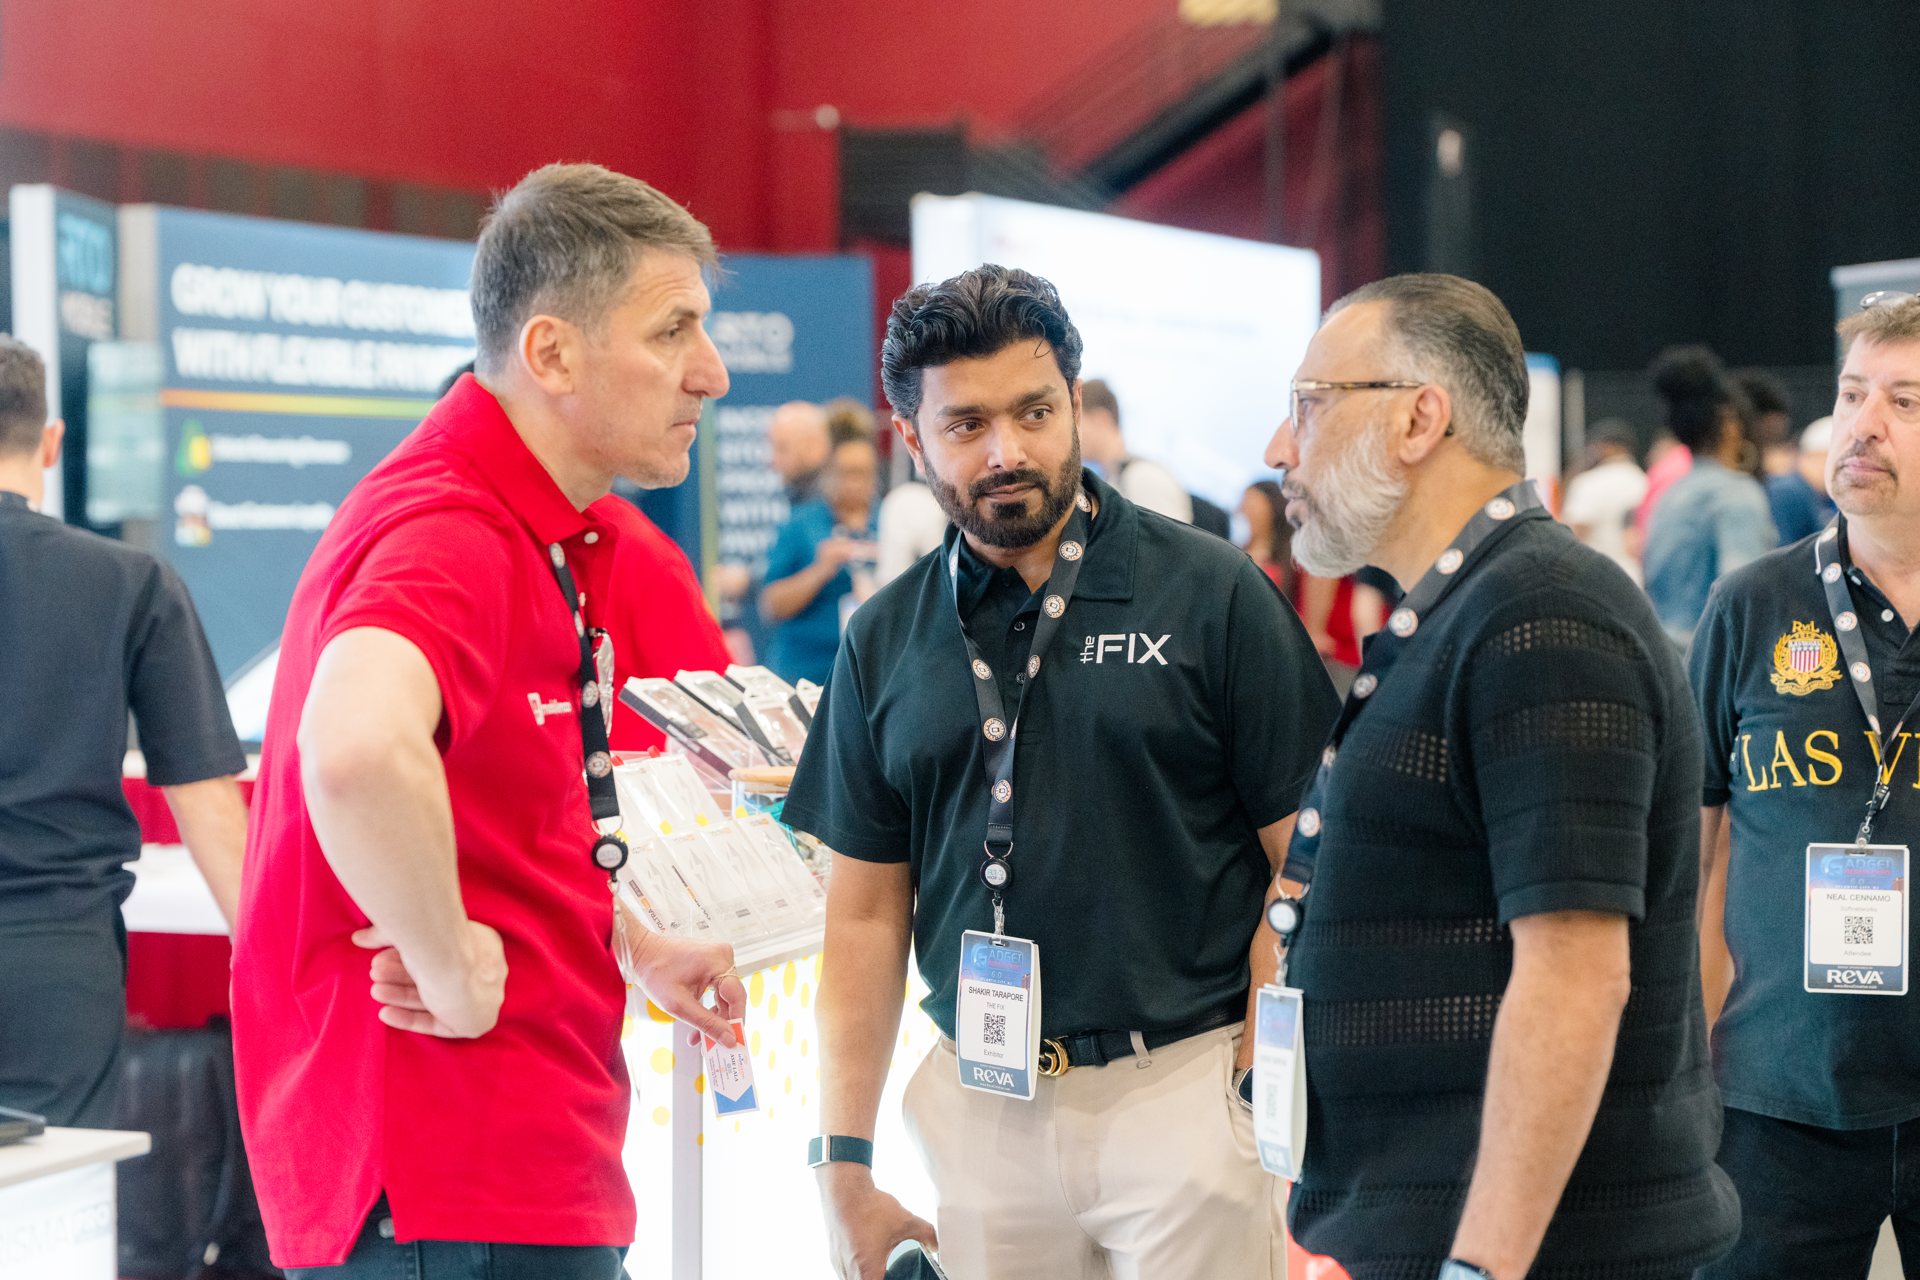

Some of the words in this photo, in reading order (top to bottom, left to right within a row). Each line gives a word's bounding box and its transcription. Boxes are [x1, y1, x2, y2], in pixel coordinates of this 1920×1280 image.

[1080, 635, 1095, 664] the
[1096, 632, 1172, 666] FIX
[1741, 730, 1843, 792] LAS
[1864, 730, 1920, 790] V
[1827, 893, 1847, 901] NEAL
[1850, 894, 1891, 902] CENNAMO
[968, 986, 991, 997] SHAKIR
[992, 989, 1024, 1002] TARAPORE
